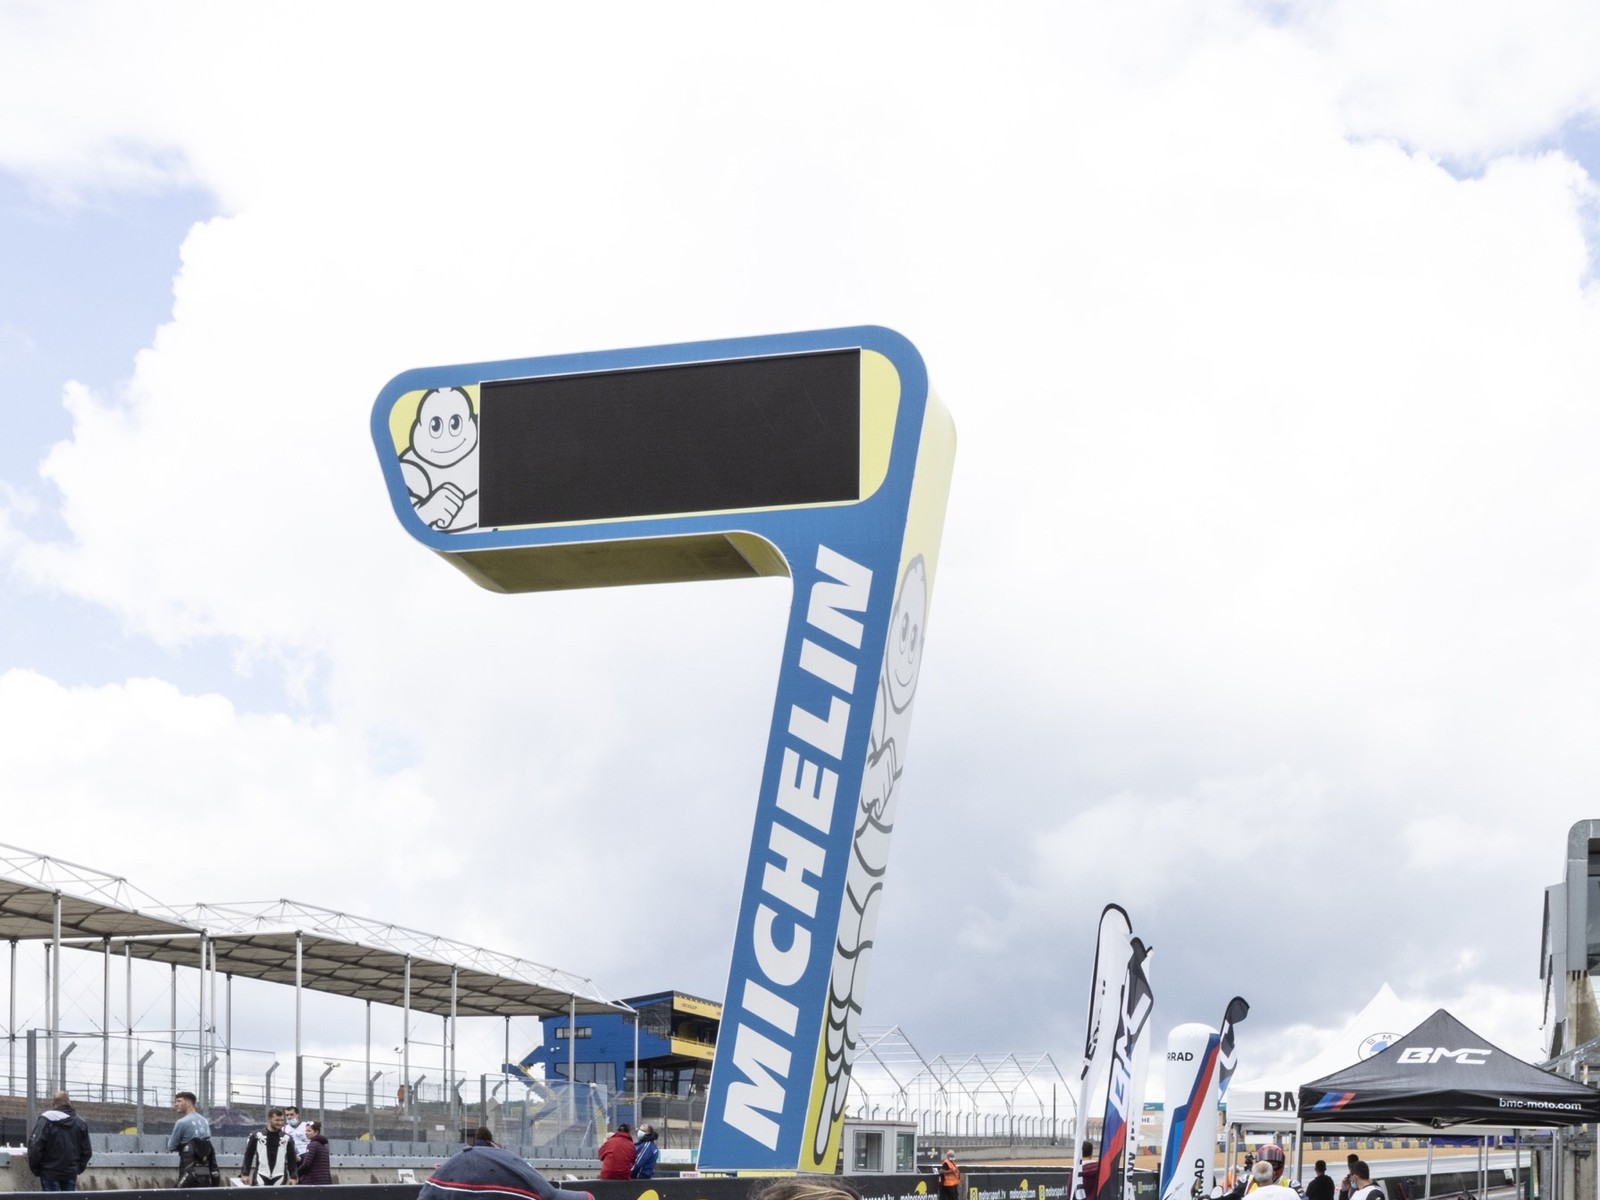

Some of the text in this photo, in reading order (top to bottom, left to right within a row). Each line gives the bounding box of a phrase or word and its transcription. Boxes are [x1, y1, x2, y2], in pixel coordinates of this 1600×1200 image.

[723, 544, 873, 1150] MICHELIN
[1397, 1047, 1493, 1065] BMC
[1499, 1097, 1582, 1111] bmc-moto.com
